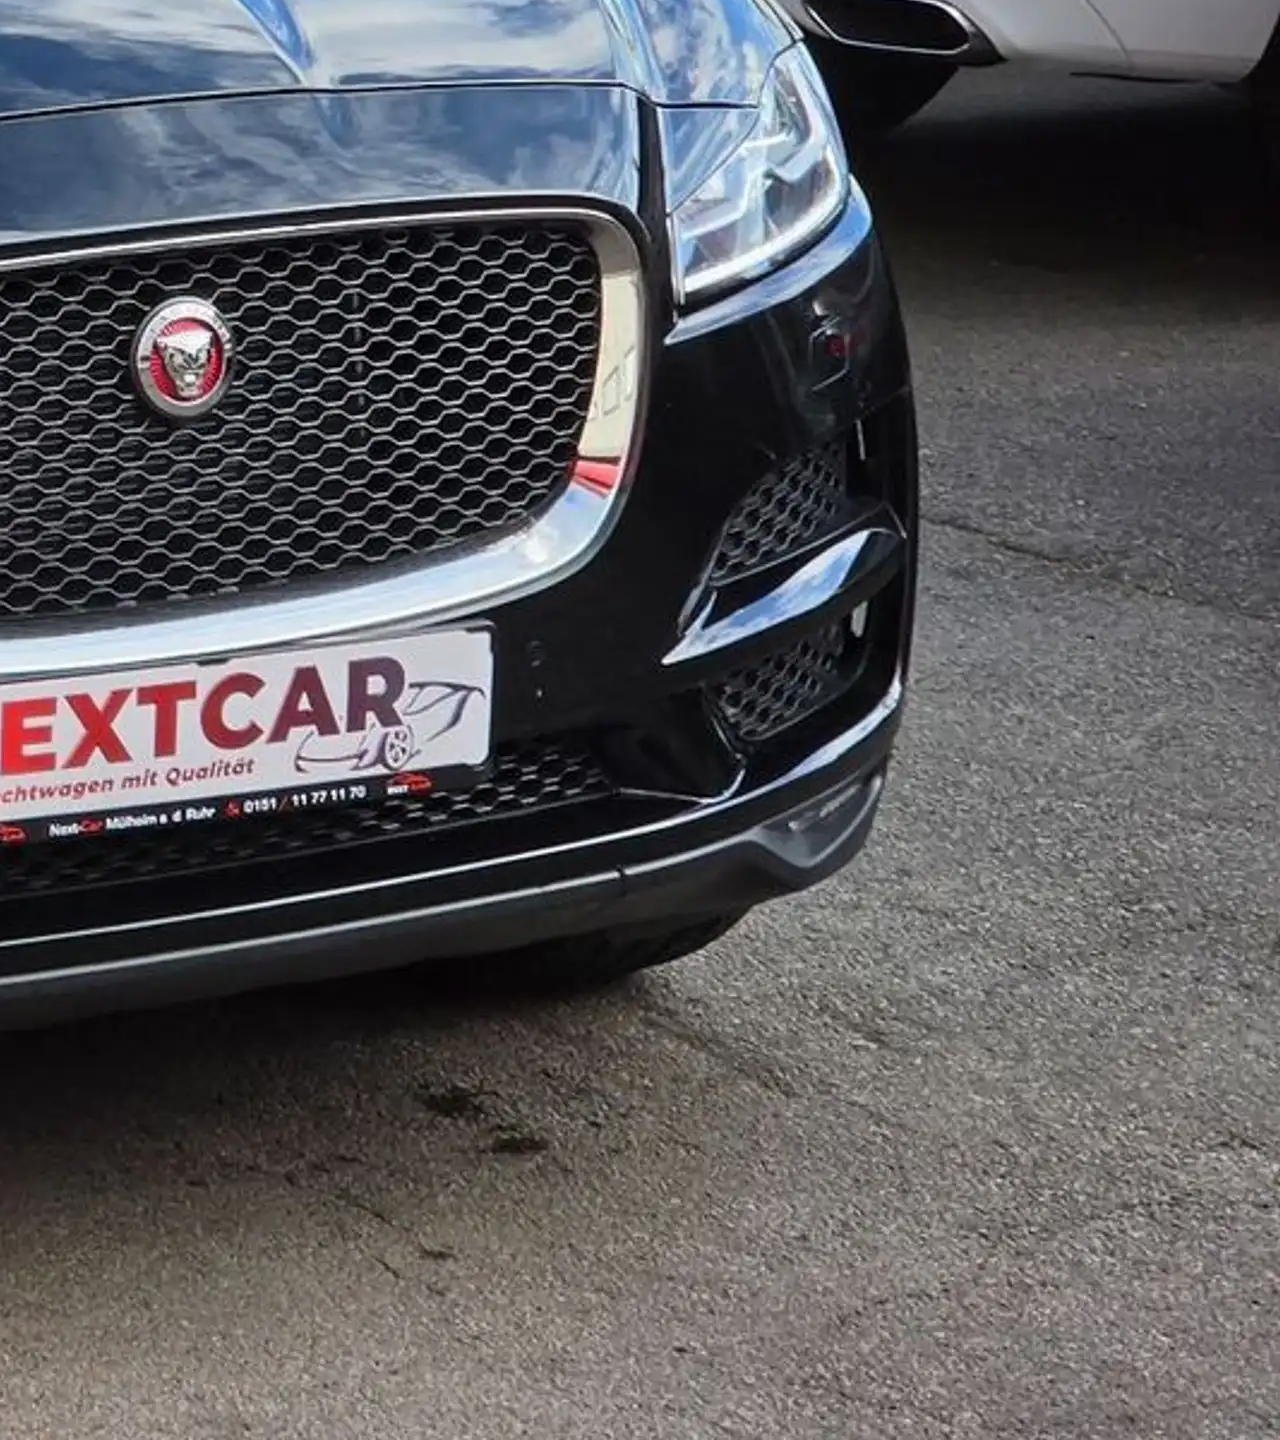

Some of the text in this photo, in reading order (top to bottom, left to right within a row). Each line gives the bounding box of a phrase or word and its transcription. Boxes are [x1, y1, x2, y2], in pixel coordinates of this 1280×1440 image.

[121, 768, 159, 791] mit
[165, 758, 255, 786] Qualität
[243, 799, 277, 814] 0151
